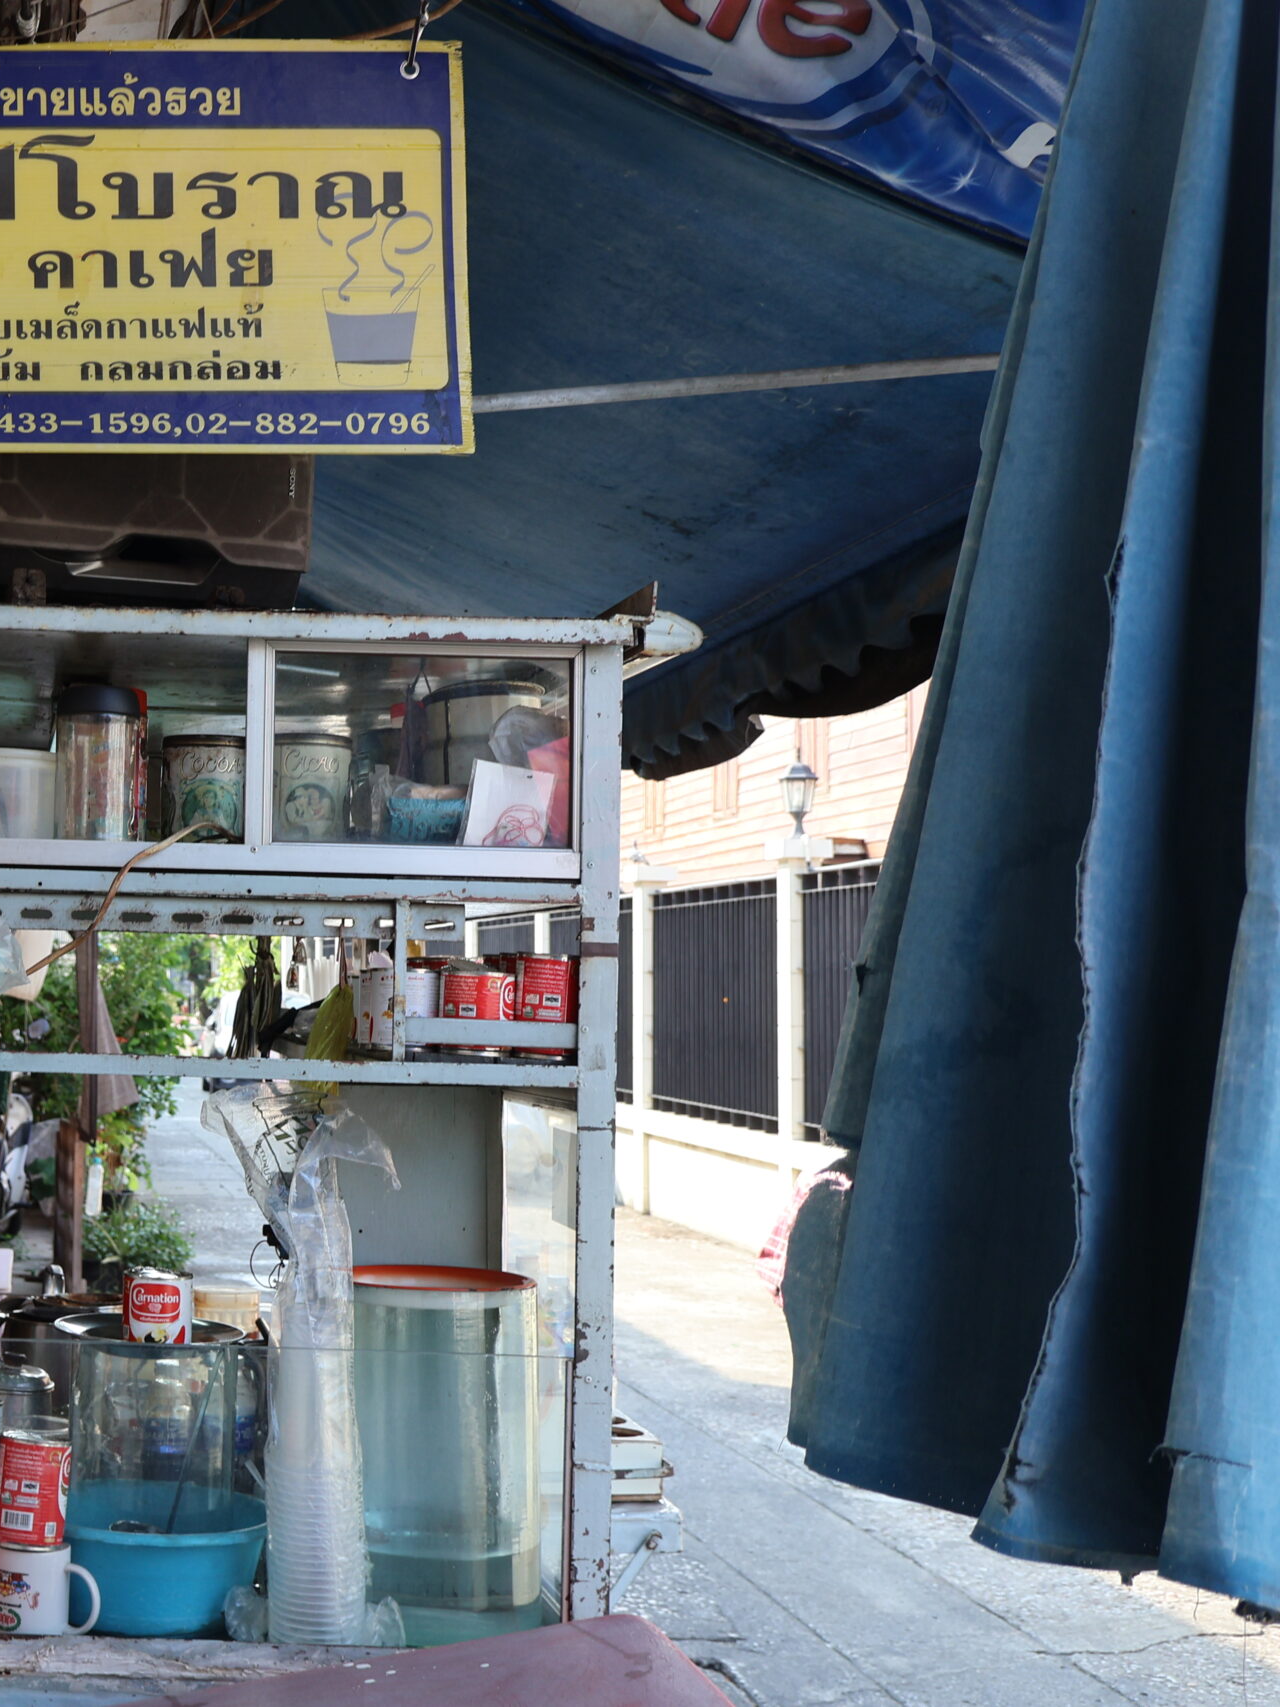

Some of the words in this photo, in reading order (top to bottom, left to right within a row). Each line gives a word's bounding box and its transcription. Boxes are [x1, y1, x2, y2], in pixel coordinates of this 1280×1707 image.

[27, 227, 273, 289] คาเฟย
[80, 350, 282, 382] กลมกล่อม
[288, 467, 296, 500] SONY
[132, 1287, 179, 1305] Carnation
